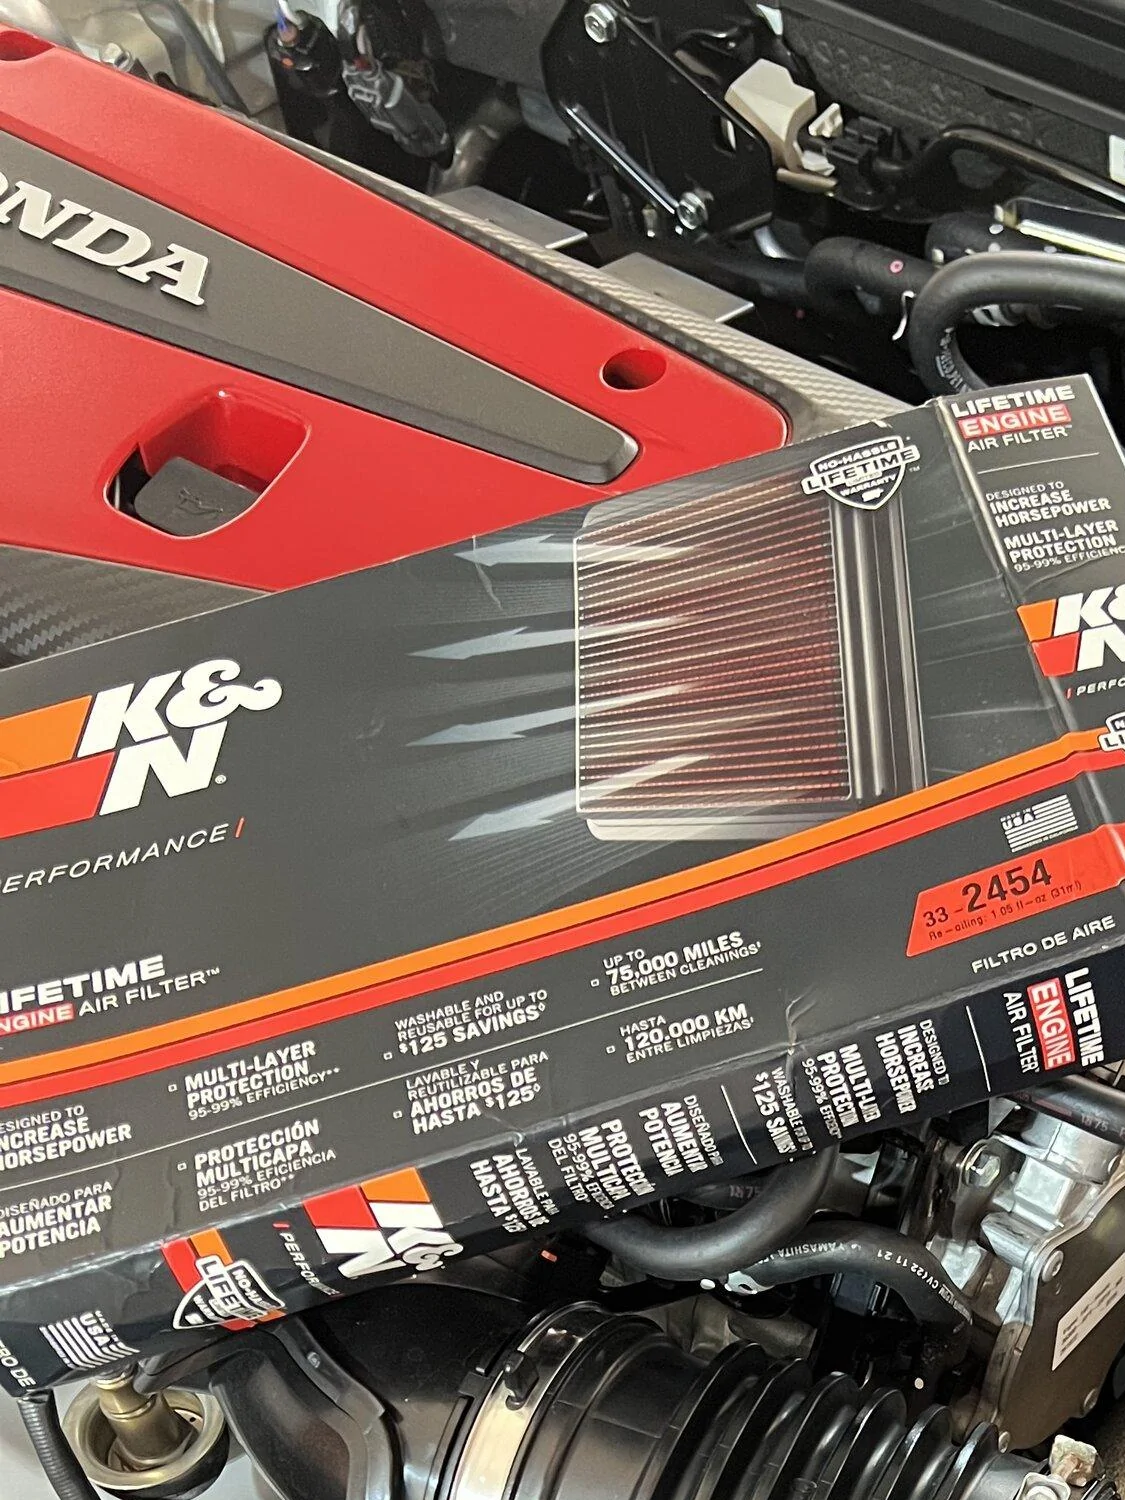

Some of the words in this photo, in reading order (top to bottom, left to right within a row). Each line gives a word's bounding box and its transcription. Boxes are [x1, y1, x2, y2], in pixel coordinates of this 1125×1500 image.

[0, 171, 208, 306] NDA
[951, 385, 1075, 418] LIFETIME
[962, 406, 1070, 438] ENGINE
[818, 442, 898, 472] NO-HASSLE
[967, 436, 999, 453] AIR
[807, 449, 916, 490] LIFETIME
[840, 474, 897, 497] WARRANTY
[986, 484, 1046, 501] DESIGNED
[1049, 481, 1064, 491] TO
[990, 490, 1073, 515] INCREASE
[995, 498, 1111, 528] HORSEPOWER
[1003, 519, 1119, 550] MULTI-LAYER
[1009, 534, 1117, 564] PROTECTION
[1014, 558, 1061, 573] 95-99%
[77, 659, 283, 817] K&N
[1002, 813, 1034, 831] USA
[0, 823, 229, 893] ERFORMANCE
[603, 955, 623, 969] UP
[626, 949, 645, 962] TO
[605, 951, 679, 985] 75,000
[682, 931, 744, 963] MILES
[971, 942, 1037, 974] FILTRO
[1042, 932, 1068, 950] DE
[1072, 915, 1116, 941] AIRE
[609, 969, 677, 996] BETWEEN
[78, 994, 119, 1017] AIR
[395, 1000, 472, 1030] WASHABLE
[474, 991, 504, 1008] AND
[397, 1012, 472, 1042] REUSABLE
[474, 1003, 502, 1018] FOR
[505, 996, 526, 1010] UP
[528, 989, 548, 1001] TO
[1003, 992, 1027, 1024] AIR
[1065, 967, 1104, 1067] LIFETIME
[619, 1015, 667, 1036] HASTA
[624, 1014, 710, 1052] 120.000
[713, 1003, 748, 1025] KM
[1031, 981, 1072, 1068] ENGINE
[399, 1031, 448, 1056] $125
[626, 1041, 674, 1064] ENTRE
[919, 1018, 948, 1075] DESIGNED
[184, 1040, 317, 1091] MULTI-LAYER
[187, 1059, 310, 1109] PROTECTION
[405, 1063, 468, 1090] LAVABLE
[470, 1059, 480, 1071] Y
[407, 1063, 508, 1101] REUTILIZABLE
[510, 1051, 549, 1071] PARA
[801, 1057, 830, 1105] 95-99%
[188, 1097, 243, 1121] 95-99%
[410, 1077, 505, 1118] AHORROS
[510, 1067, 537, 1088] DE
[752, 1071, 781, 1117] $125
[771, 1066, 803, 1127] WASHABLE
[65, 1105, 85, 1118] TO
[412, 1102, 482, 1135] HASTA
[683, 1094, 717, 1152] DISEÑADO
[194, 1118, 320, 1171] PROTECCIÓN
[547, 1138, 569, 1166] DEL
[563, 1132, 595, 1183] 95-99%
[638, 1107, 685, 1178] POTENCIA
[196, 1139, 314, 1188] MULTICAPA
[197, 1175, 253, 1200] 95-99%
[256, 1149, 336, 1182] EFICIENCIA
[515, 1147, 550, 1201] LAVABLE
[74, 1180, 113, 1200] PARA
[199, 1194, 227, 1212] DEL
[469, 1159, 512, 1218] HASTA
[492, 1154, 542, 1221] AHORROS
[0, 1194, 113, 1239] AUMENTAR
[0, 1216, 102, 1259] POTENCIA
[777, 1241, 845, 1259] YAMASHITA
[877, 1249, 893, 1261] 21
[80, 1312, 111, 1347] USA
[10, 1367, 37, 1388] DE
